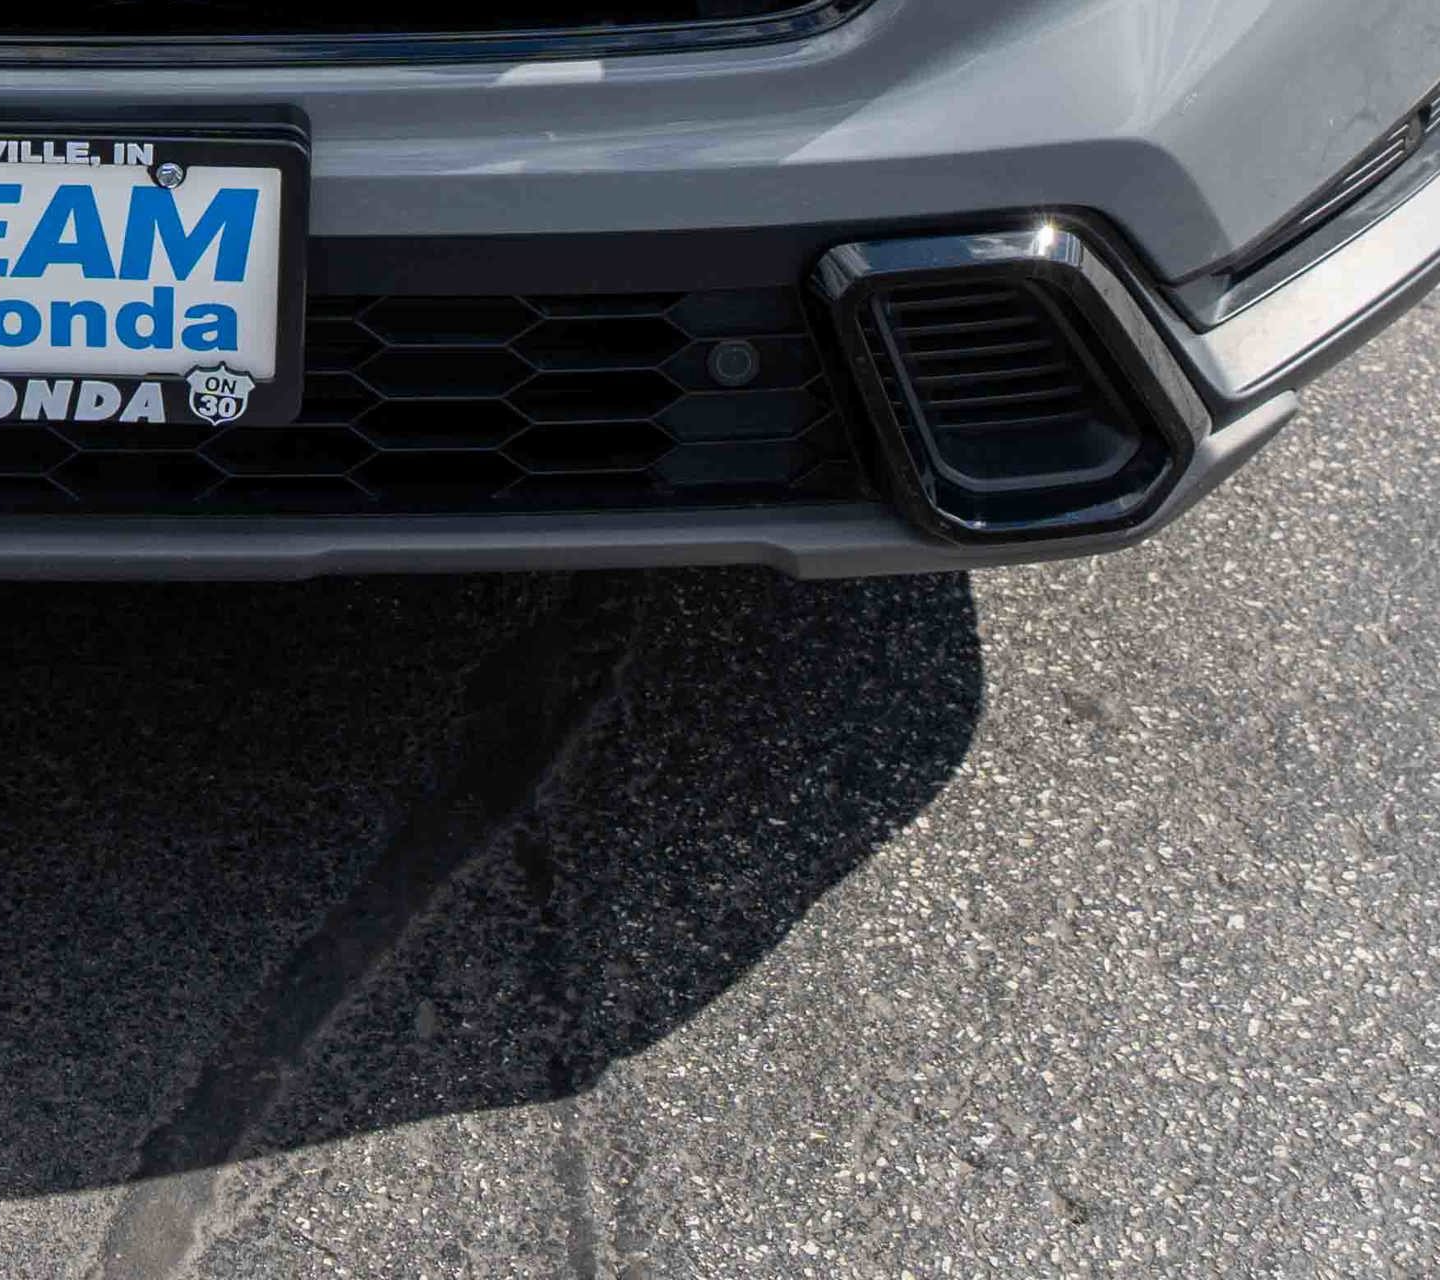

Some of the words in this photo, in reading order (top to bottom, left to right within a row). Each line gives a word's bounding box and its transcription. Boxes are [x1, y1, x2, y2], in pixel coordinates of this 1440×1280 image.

[113, 142, 154, 166] IN
[204, 376, 237, 395] ON
[198, 395, 237, 418] 30
